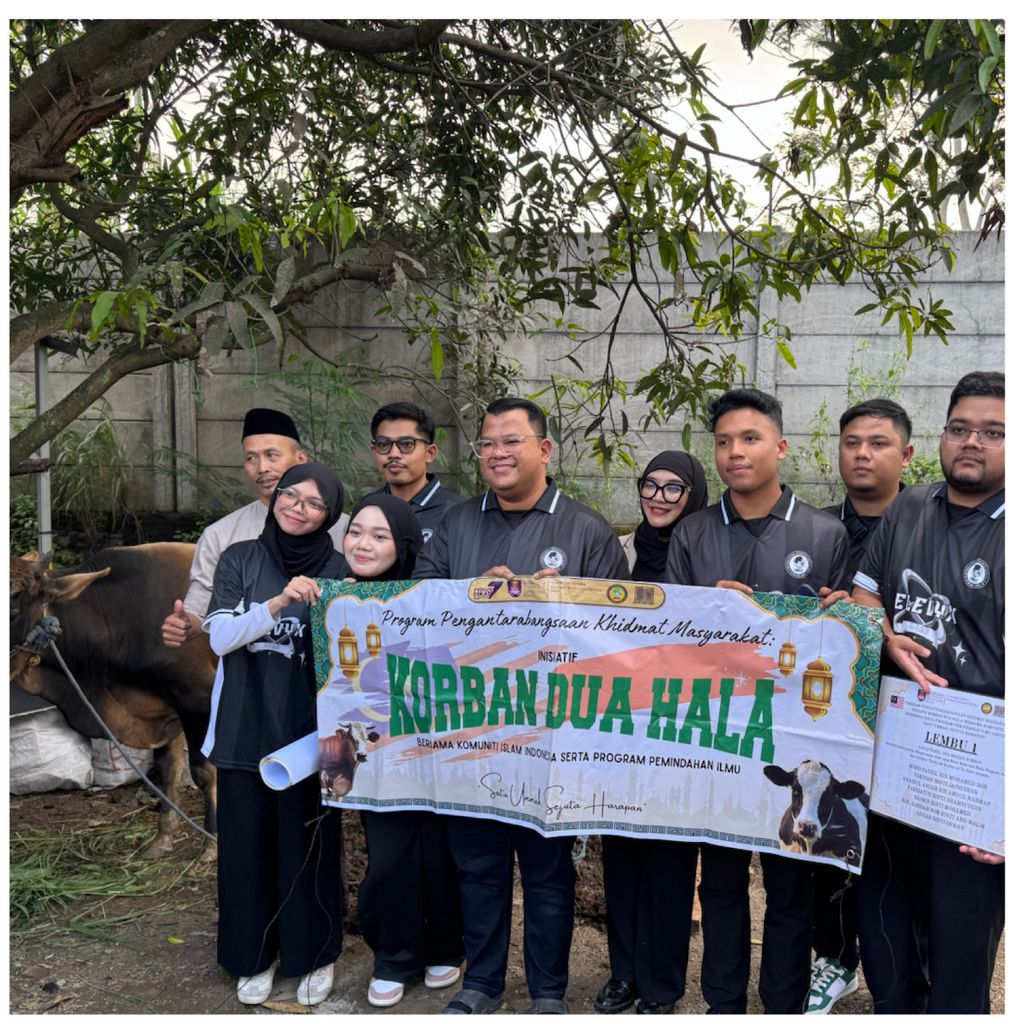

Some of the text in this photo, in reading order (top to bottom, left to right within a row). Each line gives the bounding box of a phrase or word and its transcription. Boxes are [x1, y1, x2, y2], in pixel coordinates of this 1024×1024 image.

[382, 609, 776, 647] Program Pengantarabangsaan Khidmat Masyarakat:
[538, 650, 578, 663] INISIATIF
[386, 652, 776, 764] KORBAN DUA HALA
[457, 740, 499, 751] KOMUNITI
[501, 743, 523, 756] ISLAM
[560, 752, 590, 763] SERTA
[593, 753, 646, 765] PROGRAM
[649, 757, 714, 770] PEMINDAHAN
[716, 764, 741, 775] ILMU
[924, 731, 969, 752] LEMBU
